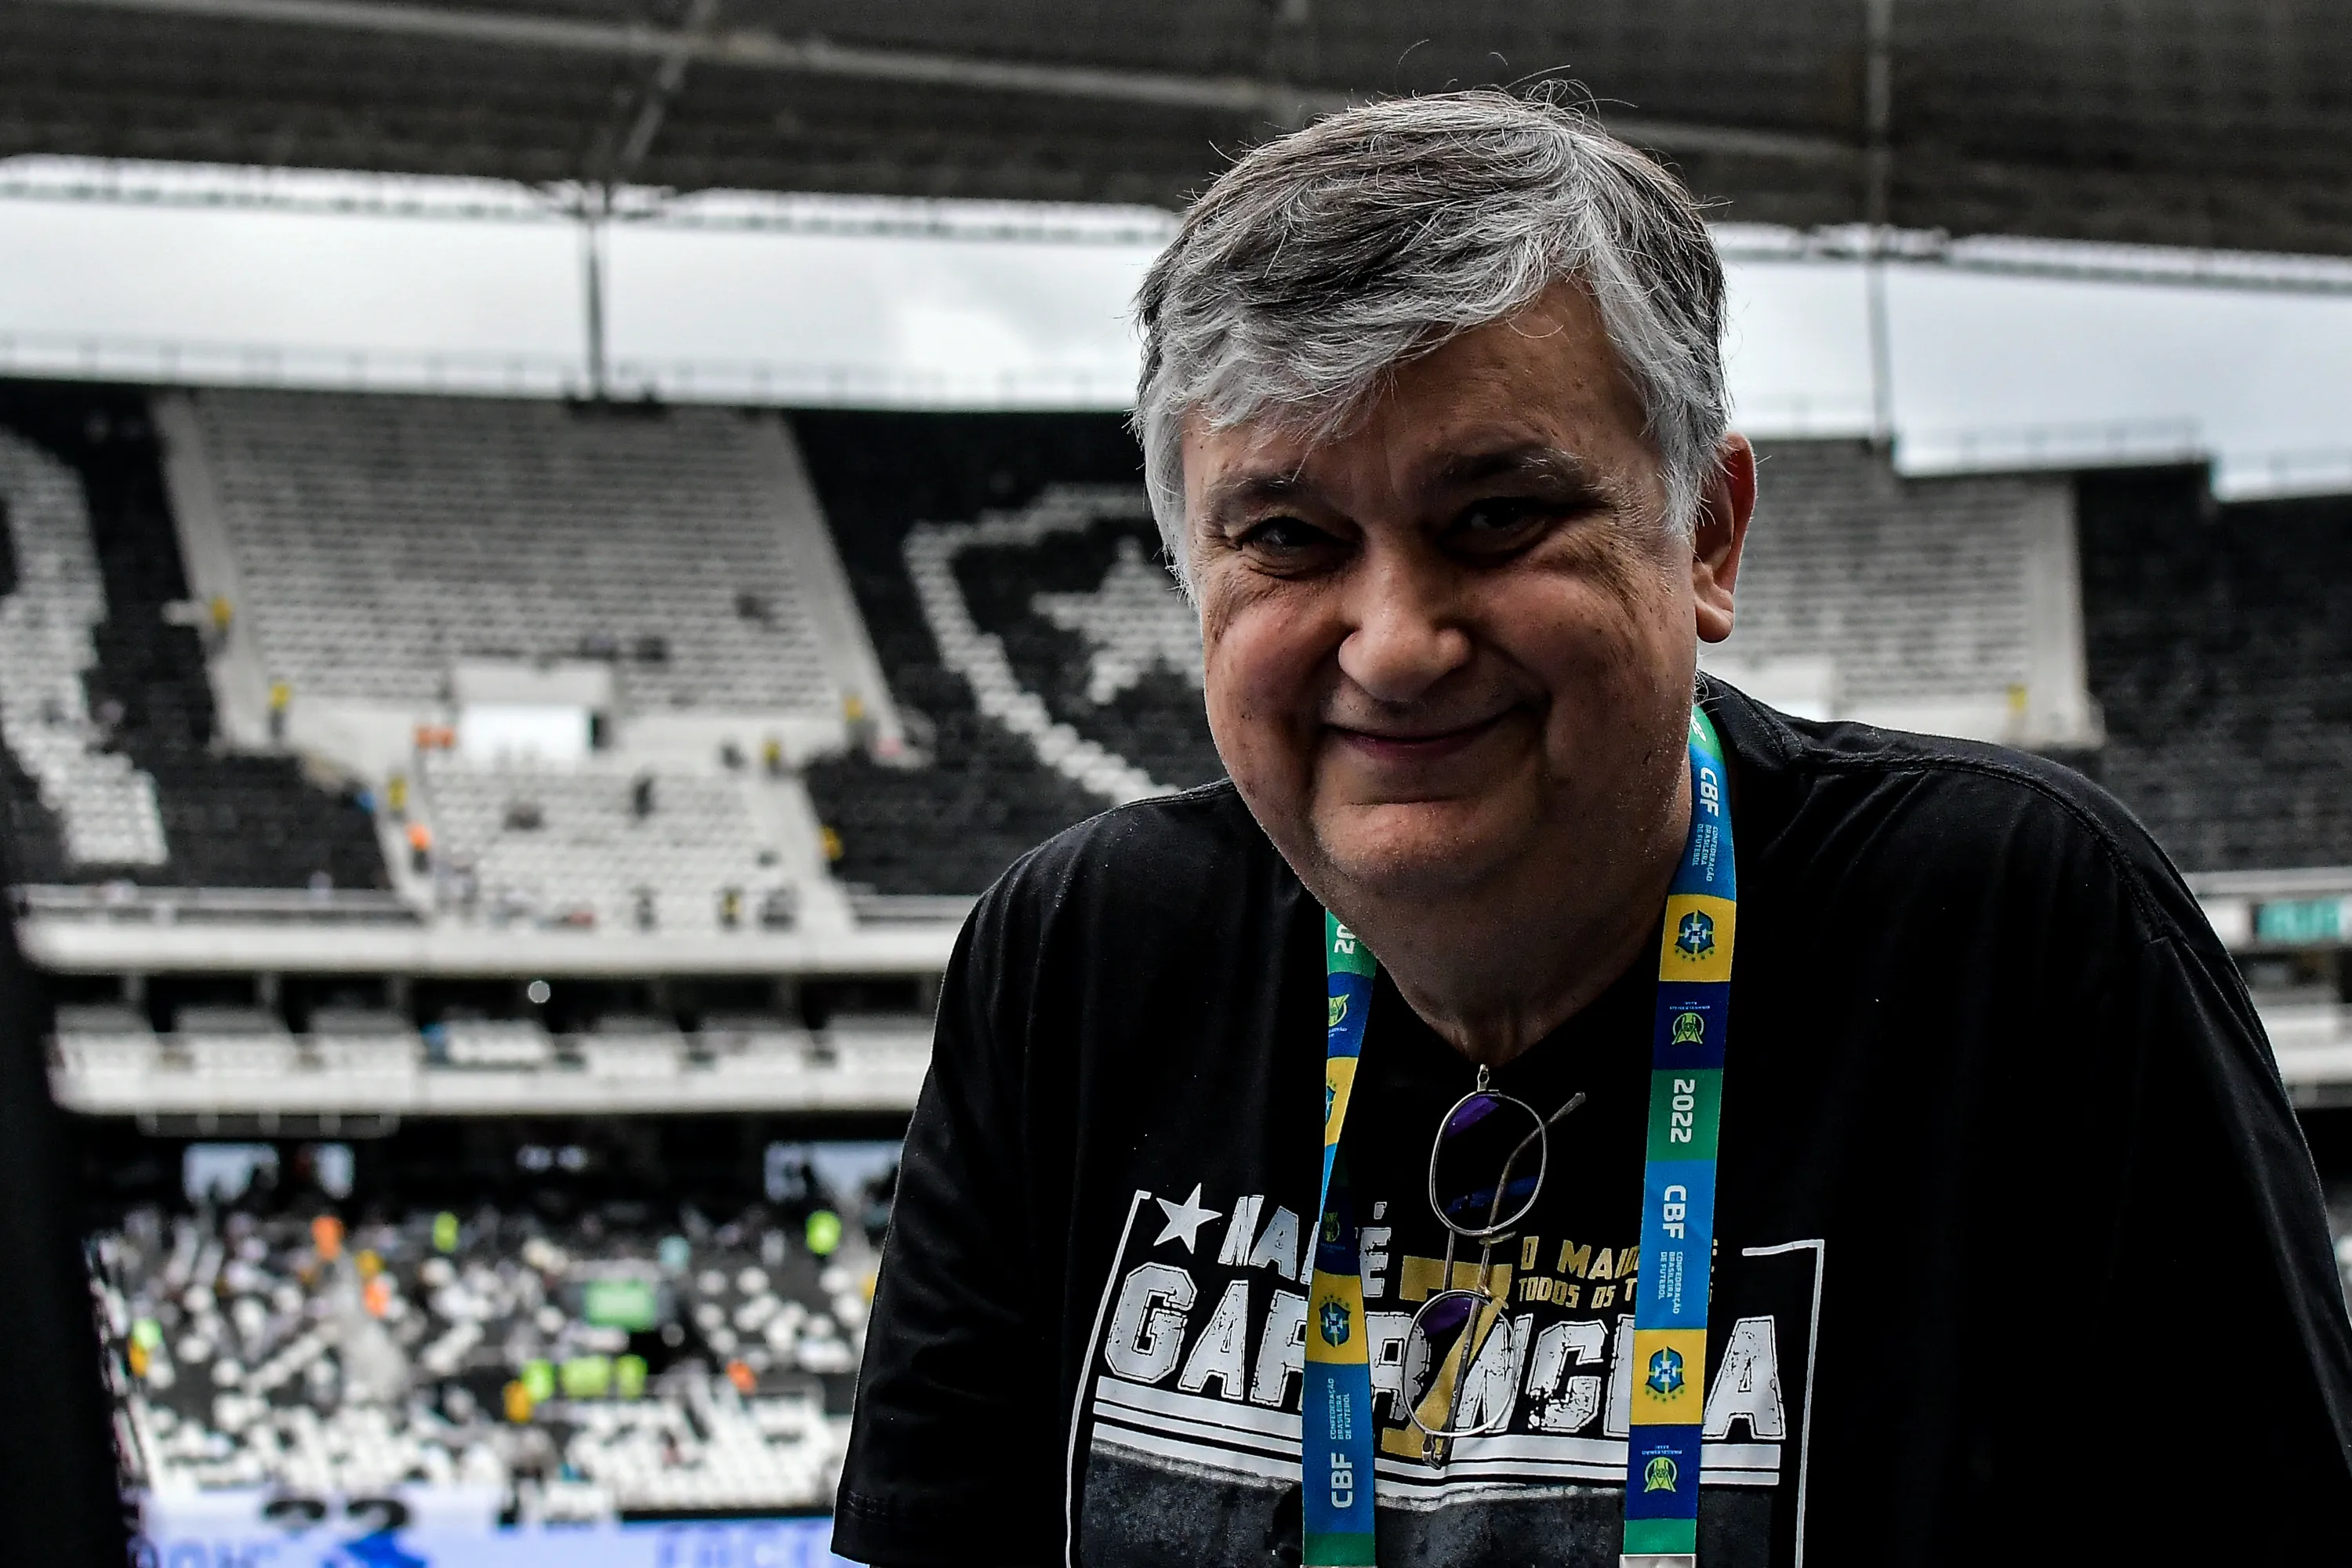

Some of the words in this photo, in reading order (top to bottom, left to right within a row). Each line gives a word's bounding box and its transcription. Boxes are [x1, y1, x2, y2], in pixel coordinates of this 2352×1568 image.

[1700, 766, 1719, 818] CBF
[1334, 924, 1356, 954] 20
[1670, 1079, 1695, 1143] 2022
[1662, 1185, 1686, 1240] CBF
[1218, 1195, 1392, 1298] MAÉ
[1556, 1239, 1640, 1279] MAIO
[1660, 1251, 1668, 1262] DE
[1519, 1276, 1581, 1308] TODOS
[1591, 1285, 1617, 1308] OS
[1658, 1264, 1667, 1300] FUTEBOL
[1667, 1251, 1675, 1298] BRASILEIRA
[1336, 1395, 1345, 1440] BRASILEIRA
[1330, 1452, 1353, 1508] CBF
